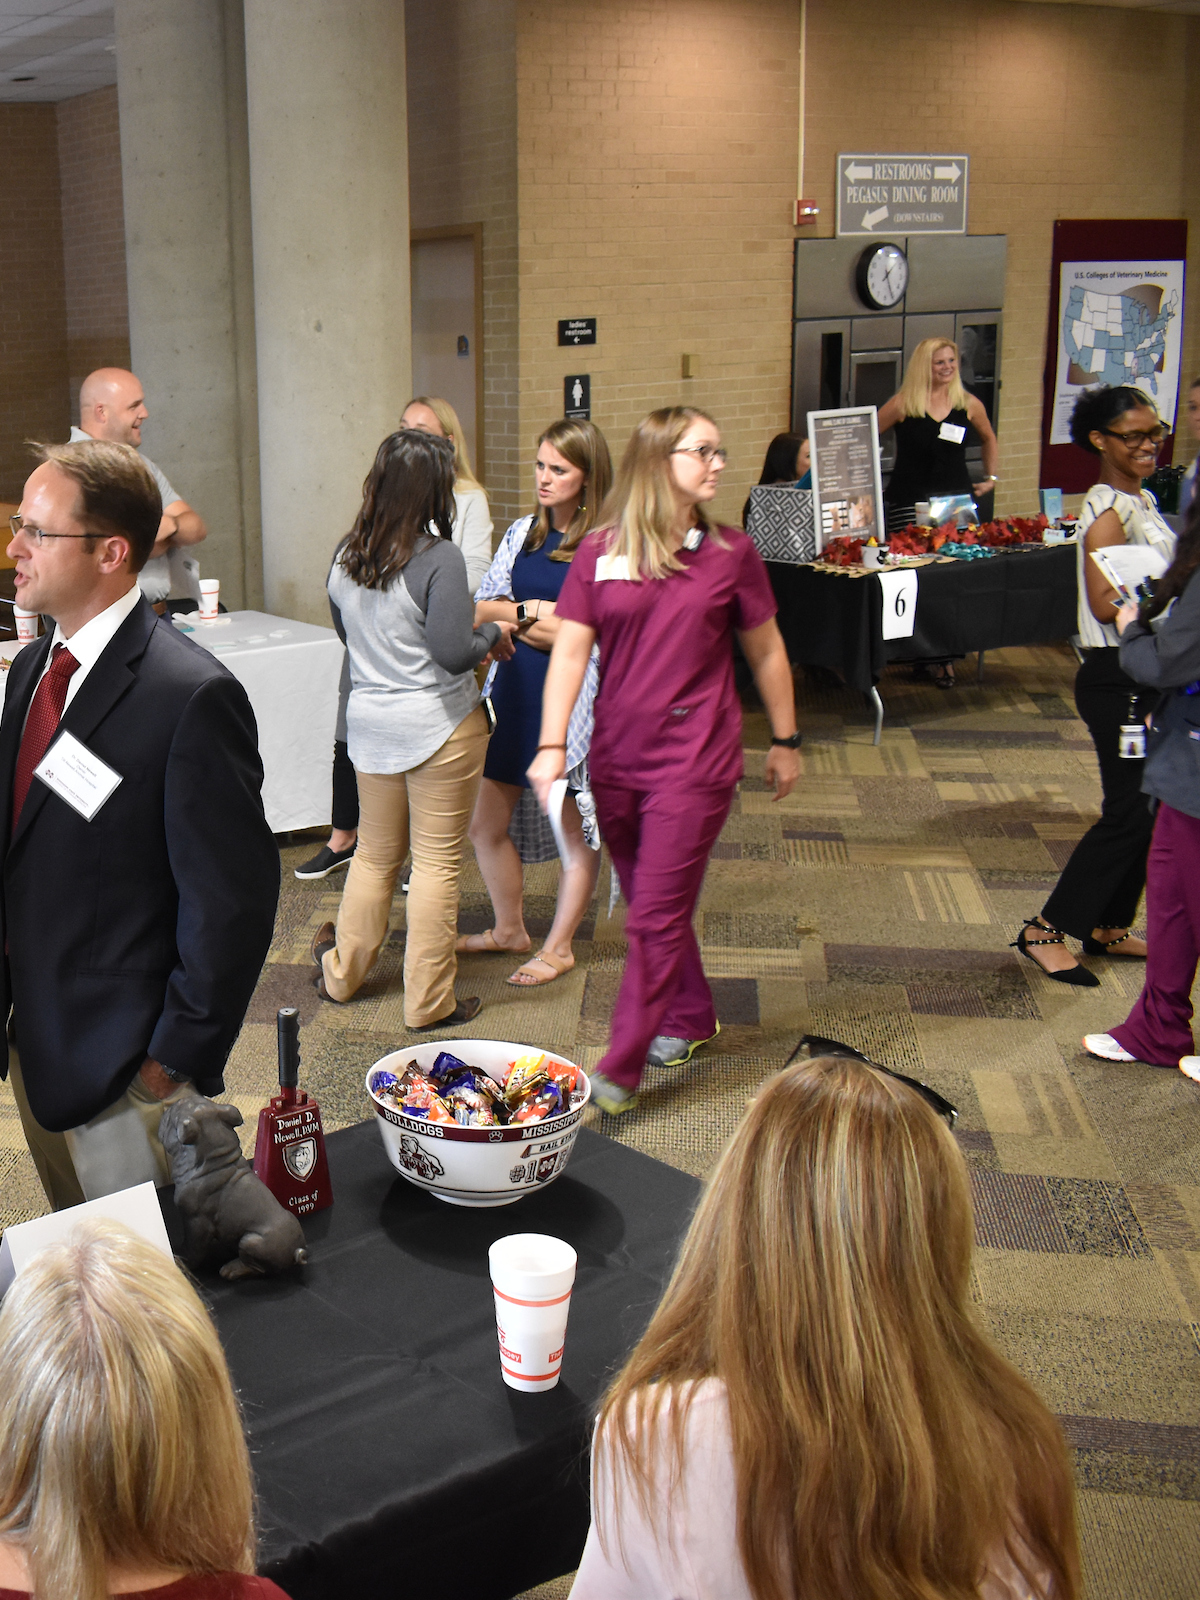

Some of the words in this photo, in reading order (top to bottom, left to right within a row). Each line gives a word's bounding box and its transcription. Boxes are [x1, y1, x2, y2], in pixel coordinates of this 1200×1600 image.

[874, 163, 932, 181] RESTROOMS
[846, 186, 889, 203] PEGASUS
[892, 186, 927, 203] DINING
[930, 186, 958, 203] ROOM
[893, 212, 944, 223] (DOWNSTAIRS)
[1074, 271, 1085, 279] U.S.
[1086, 271, 1109, 280] Colleges
[1109, 271, 1116, 279] of
[1117, 270, 1143, 279] Veterinary
[1144, 270, 1168, 278] Medicine
[564, 328, 593, 336] restroom
[895, 587, 907, 617] 6
[277, 1114, 303, 1131] Daniel
[305, 1111, 316, 1122] D.
[383, 1109, 444, 1138] BULLDOGS
[540, 1141, 558, 1152] HAIL
[288, 1194, 310, 1207] Class
[312, 1190, 319, 1201] of
[298, 1202, 315, 1214] 1999
